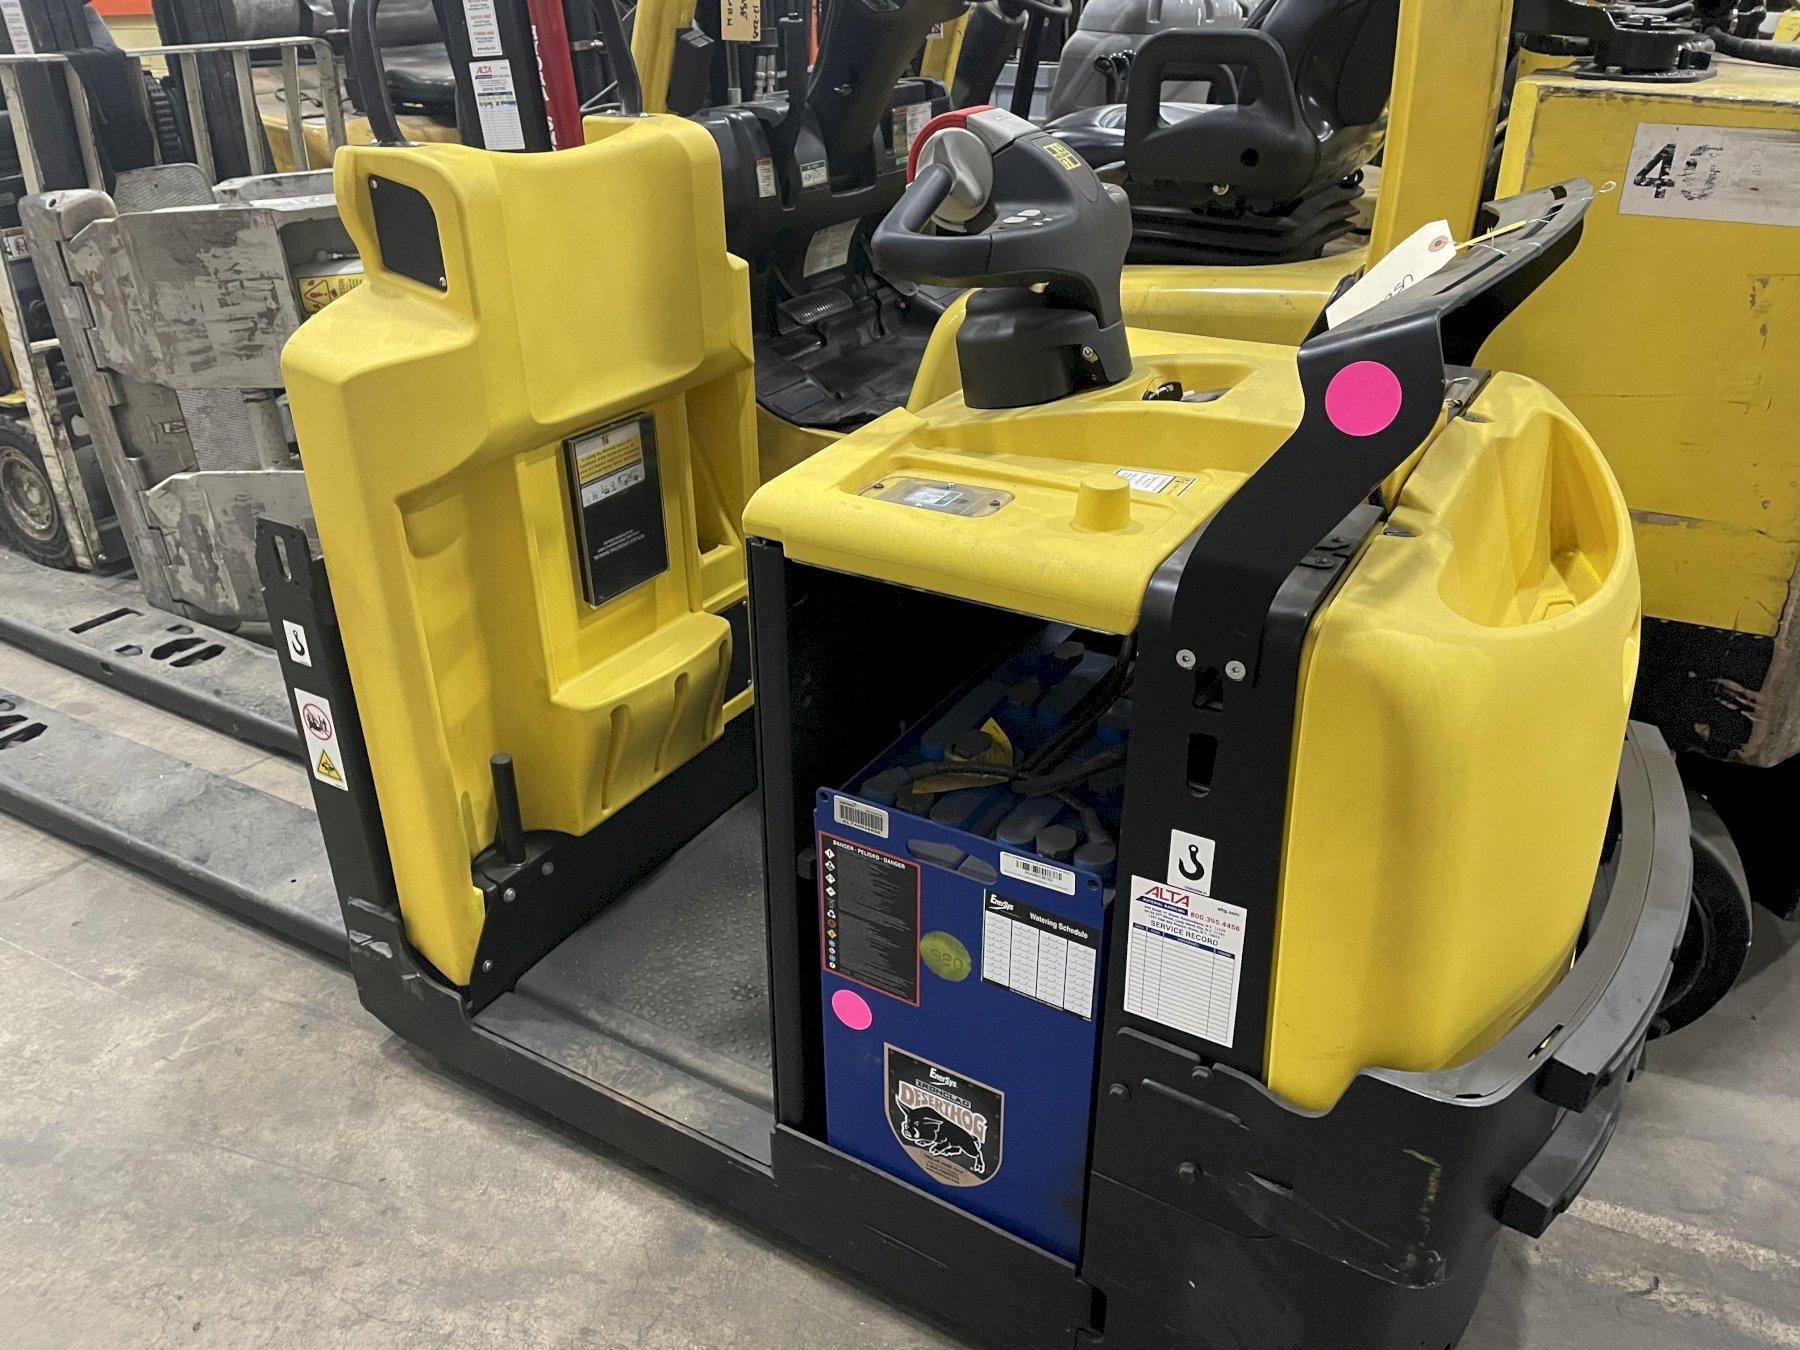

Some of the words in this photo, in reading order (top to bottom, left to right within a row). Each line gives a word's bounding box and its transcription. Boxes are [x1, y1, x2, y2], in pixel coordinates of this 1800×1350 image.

[833, 840, 854, 851] DANGER
[857, 848, 880, 860] PELIGRO
[883, 858, 906, 869] DANGER
[990, 894, 1014, 911] EnerSys
[1145, 886, 1190, 908] ALTA
[1029, 912, 1058, 929] Watering
[1058, 922, 1089, 939] Schedule
[1150, 920, 1184, 935] SERVICE
[1185, 930, 1219, 946] RECORD
[1190, 911, 1241, 932] 800.395.4456
[929, 1067, 958, 1088] EnerSys
[916, 1080, 970, 1107] IRONCLAD
[899, 1080, 988, 1144] DESERTHOG
